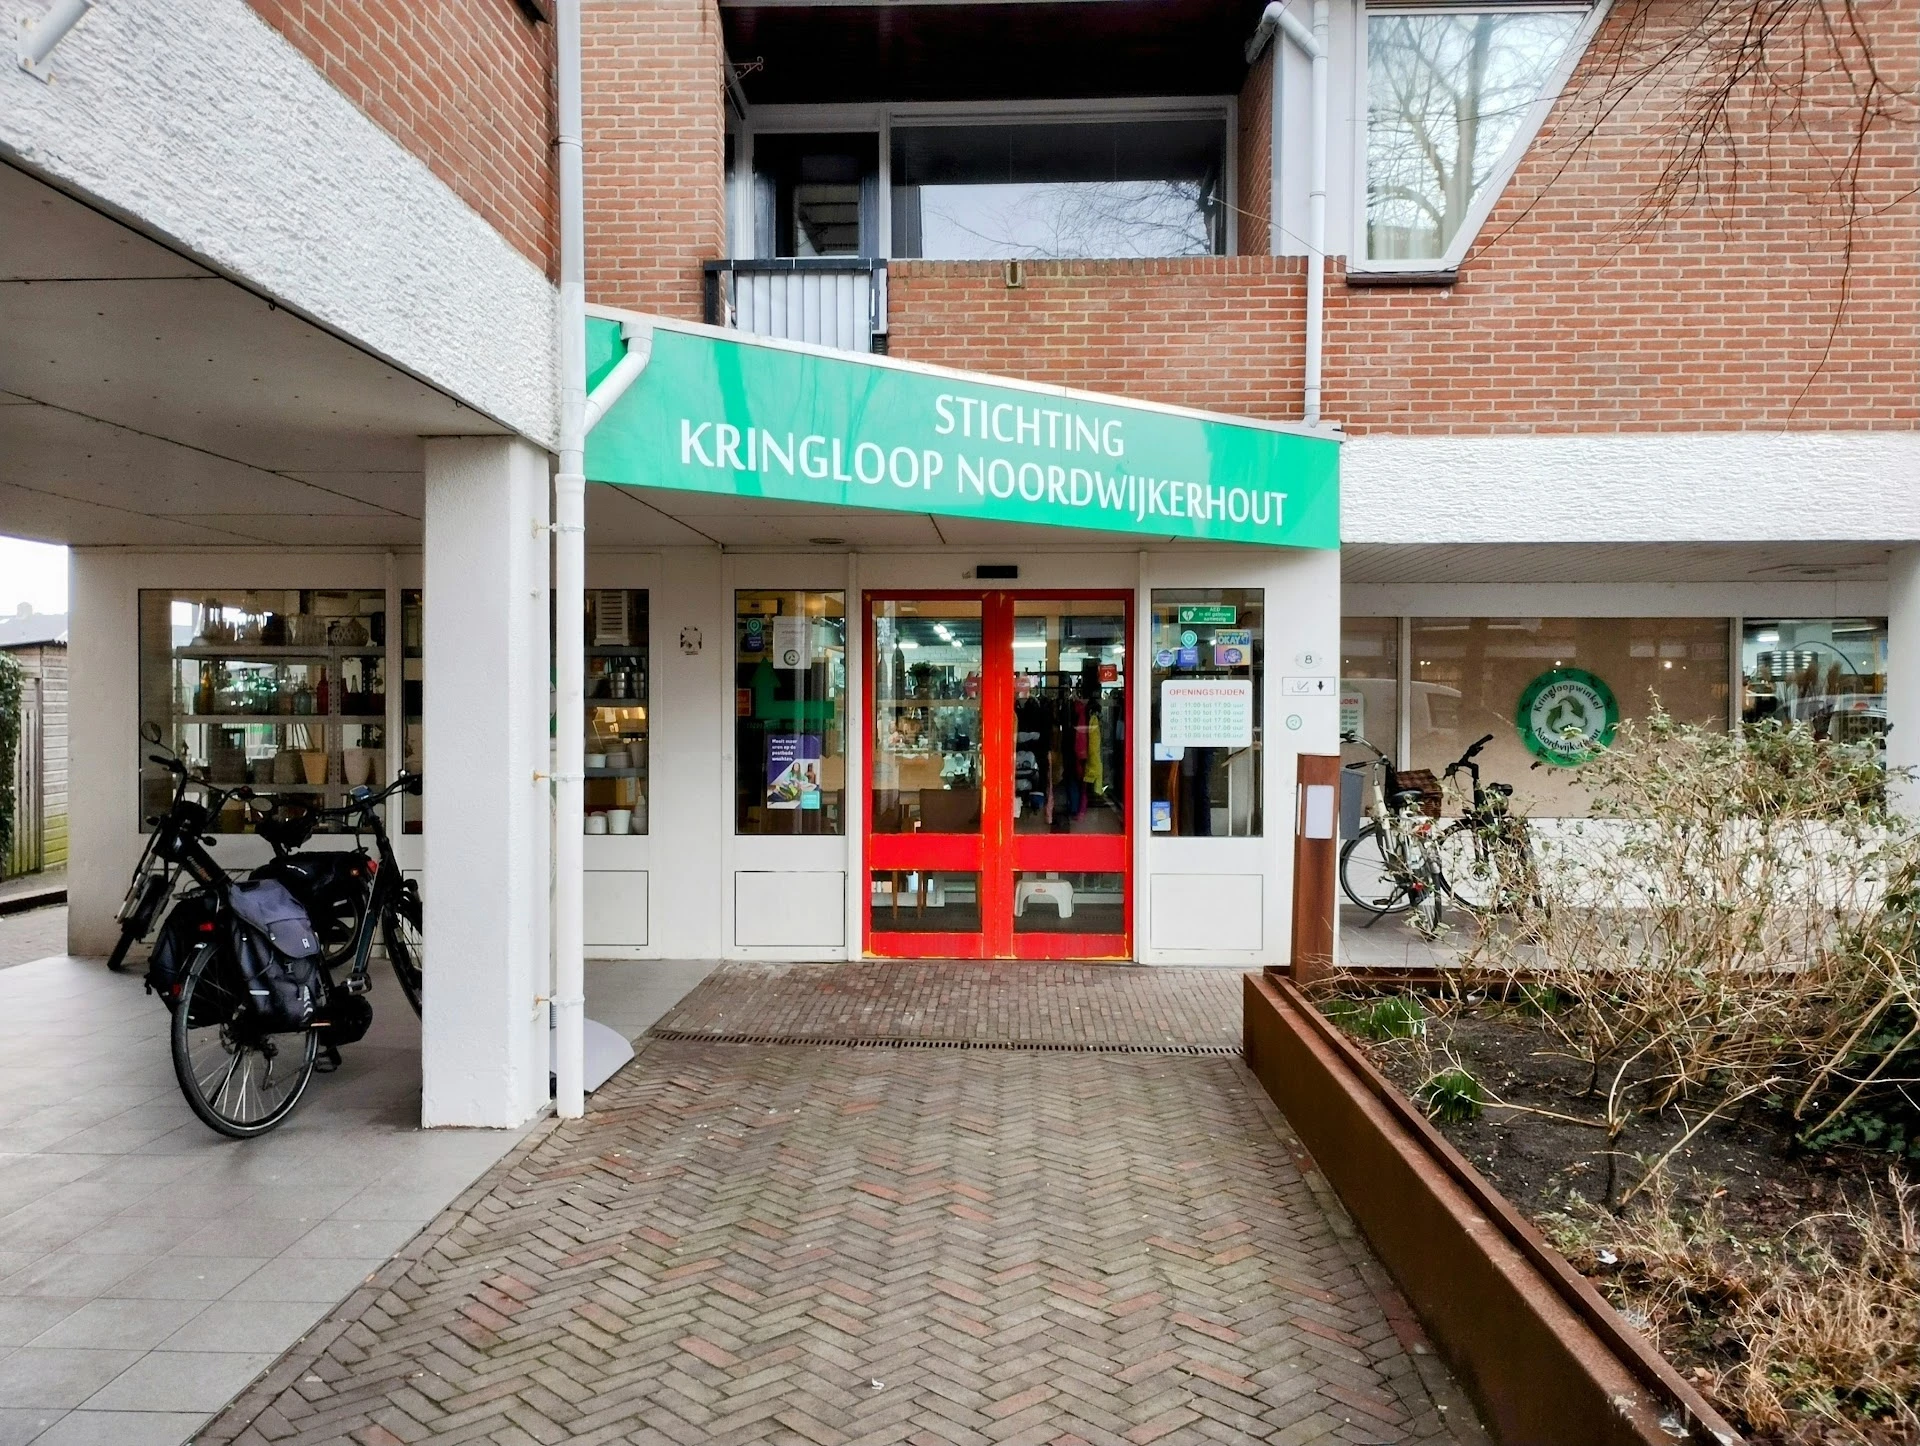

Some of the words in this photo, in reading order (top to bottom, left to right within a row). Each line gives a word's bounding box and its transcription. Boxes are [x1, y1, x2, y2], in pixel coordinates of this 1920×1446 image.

[934, 393, 1124, 457] STICHTING
[681, 418, 943, 490] KRINGLOOP
[957, 453, 1288, 526] NOORDWIJKERHOUT
[1305, 655, 1313, 664] 8
[1169, 688, 1245, 696] OPENINGSTIJDEN
[1533, 684, 1603, 712] Kringloopwinkel
